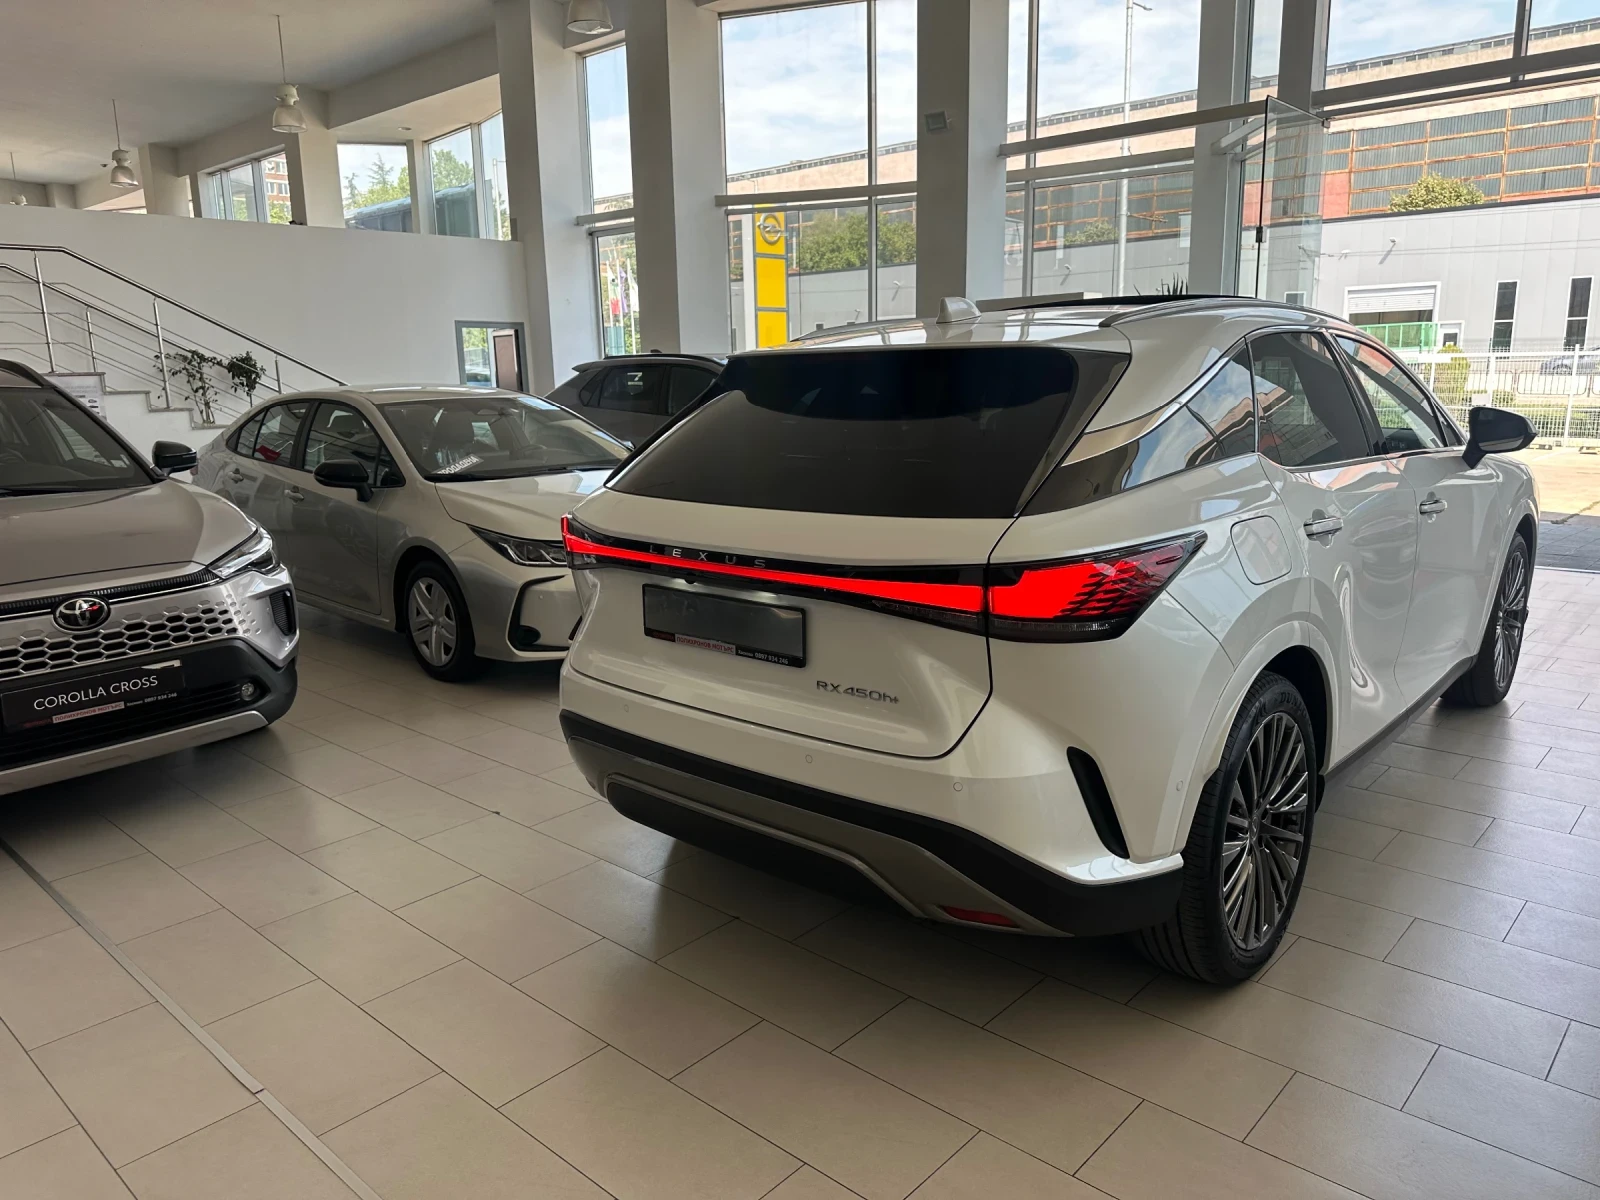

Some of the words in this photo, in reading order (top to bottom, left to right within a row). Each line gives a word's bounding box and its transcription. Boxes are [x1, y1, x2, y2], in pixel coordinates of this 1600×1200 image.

[650, 545, 766, 569] LEXUS
[33, 686, 107, 710] COROLLA
[110, 675, 158, 694] CROSS
